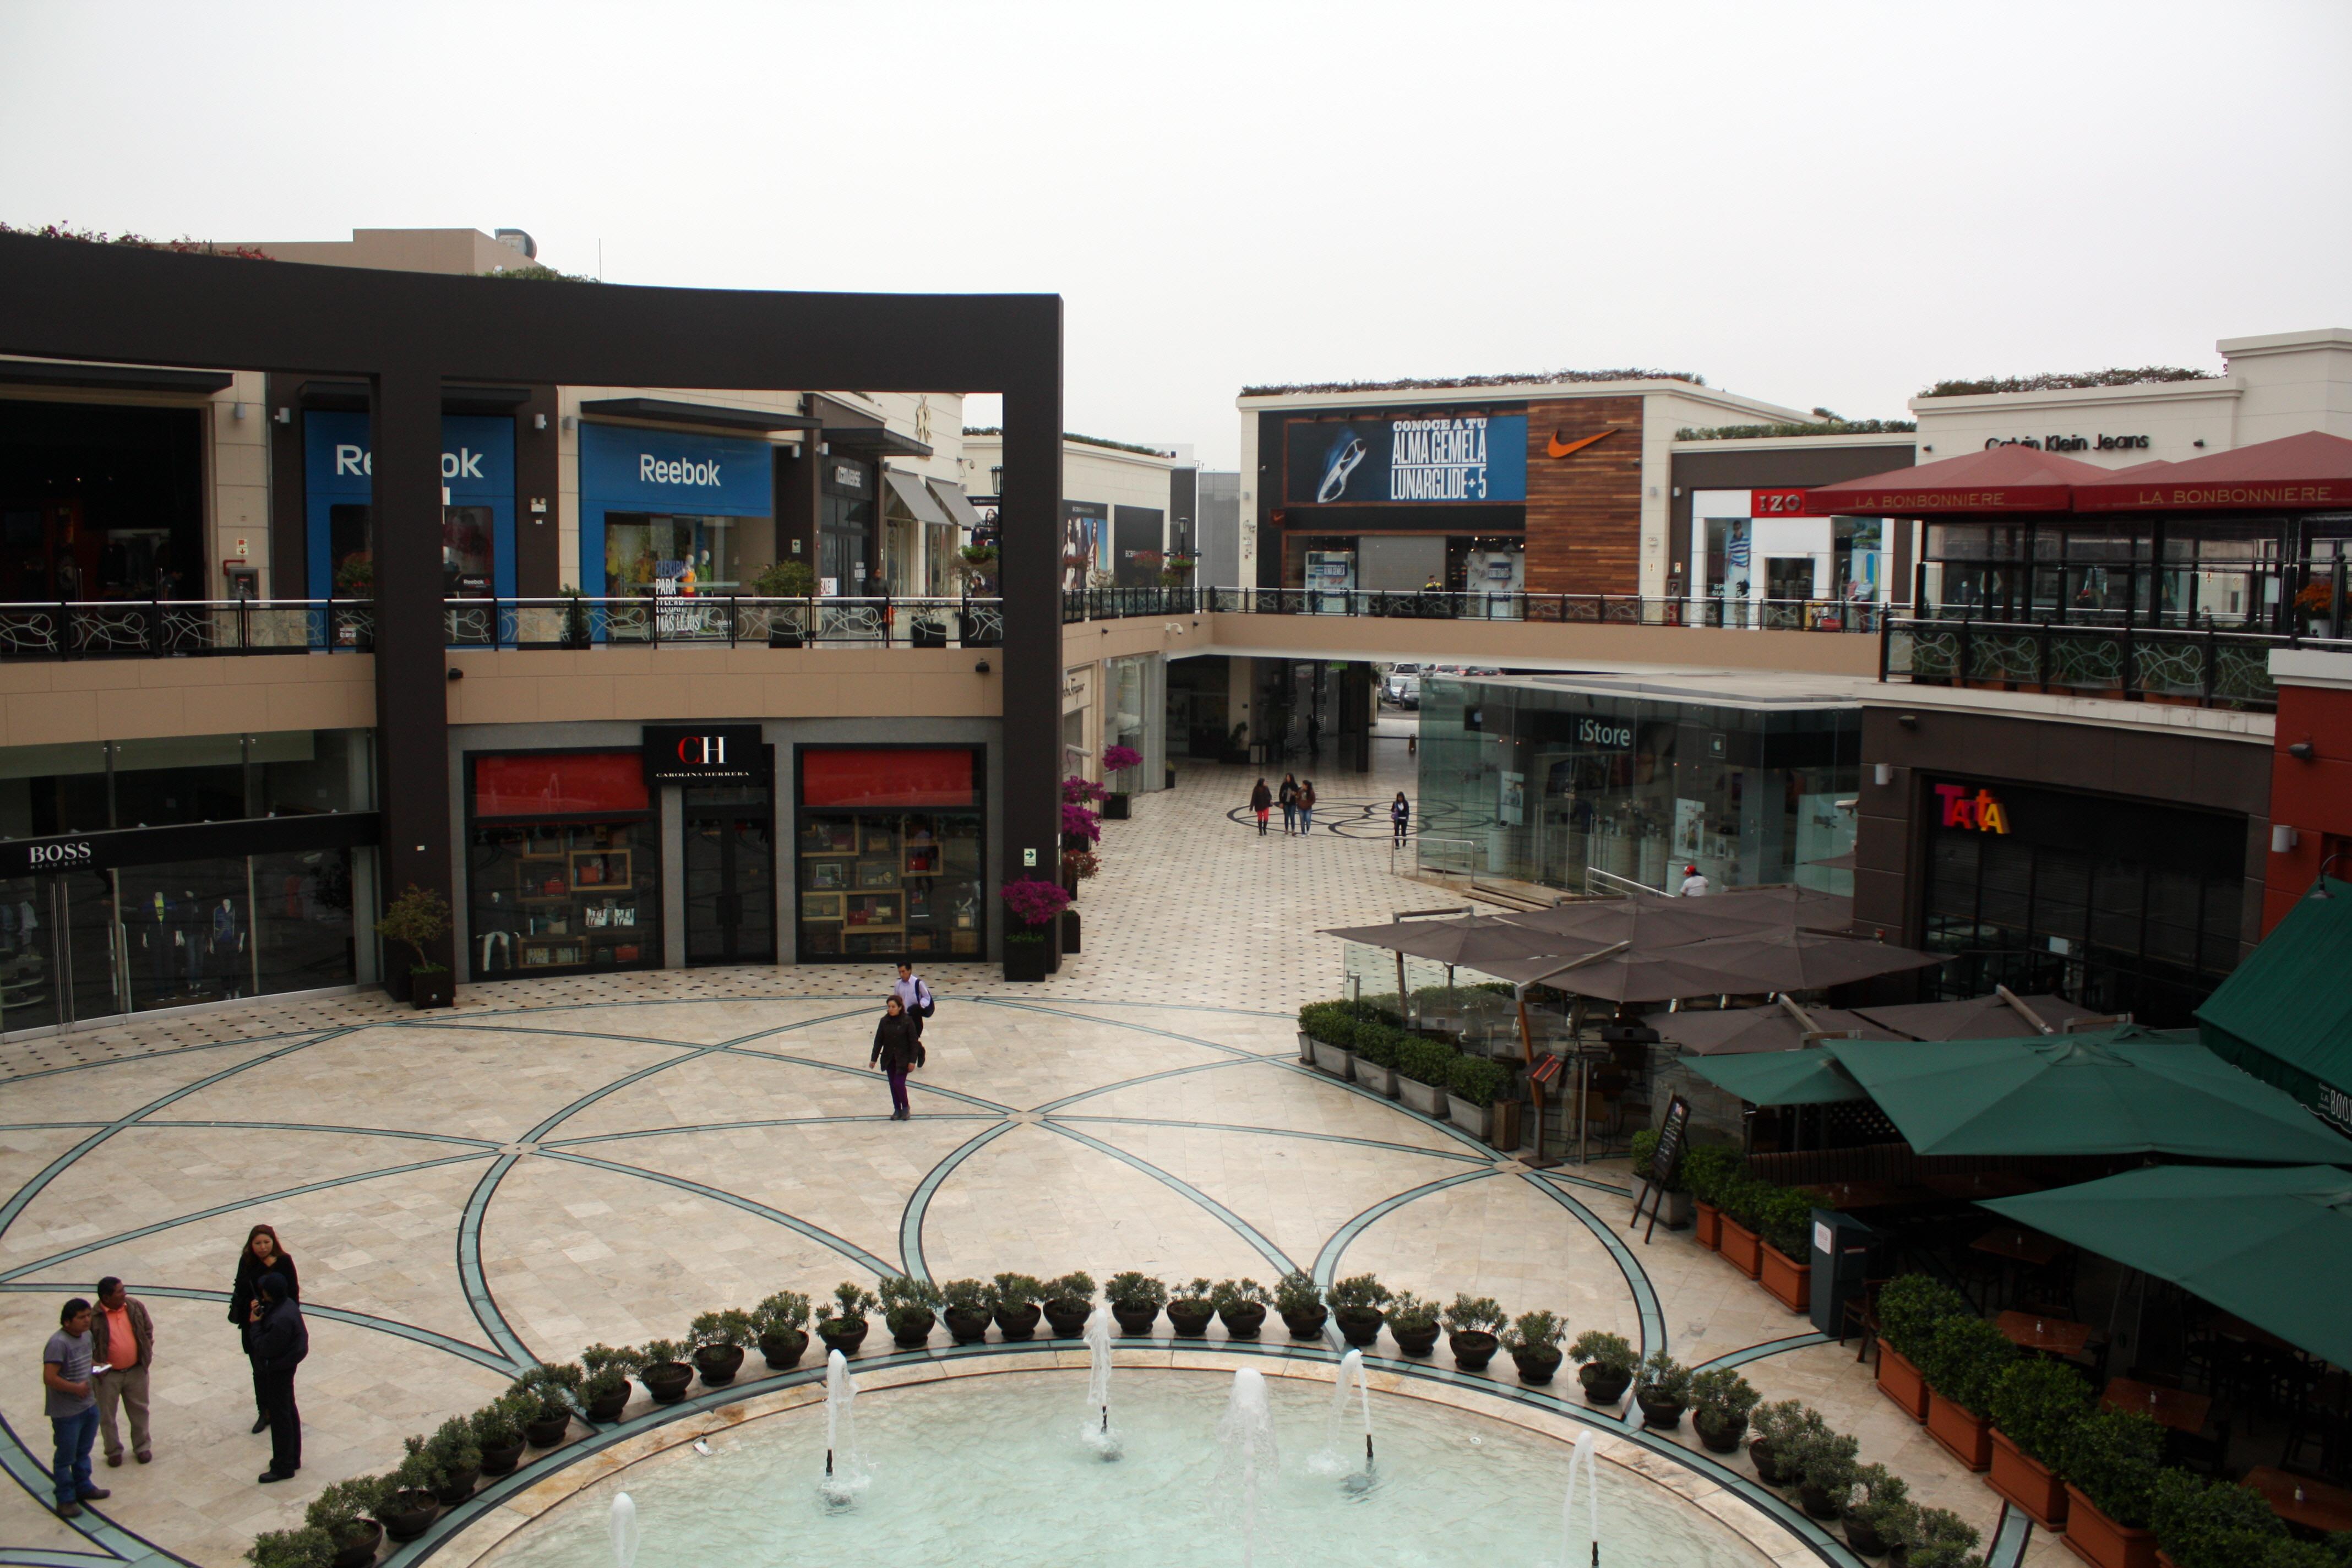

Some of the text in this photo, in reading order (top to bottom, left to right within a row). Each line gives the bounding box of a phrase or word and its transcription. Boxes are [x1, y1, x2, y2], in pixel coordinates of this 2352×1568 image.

[1392, 417, 1488, 432] CONOCE A TU
[1392, 429, 1487, 464] ALMA GEMELA
[2045, 434, 2088, 451] Klein
[2093, 433, 2149, 450] Jeans
[640, 453, 721, 487] Reebok
[1758, 494, 1805, 511] IZO
[1856, 493, 2005, 508] LA BONBONNIERE
[2139, 487, 2332, 504] LA BONBONNIERE
[656, 578, 677, 595] PARA
[1579, 718, 1631, 747] iStore
[677, 736, 727, 765] CH
[29, 842, 91, 863] BOSS
